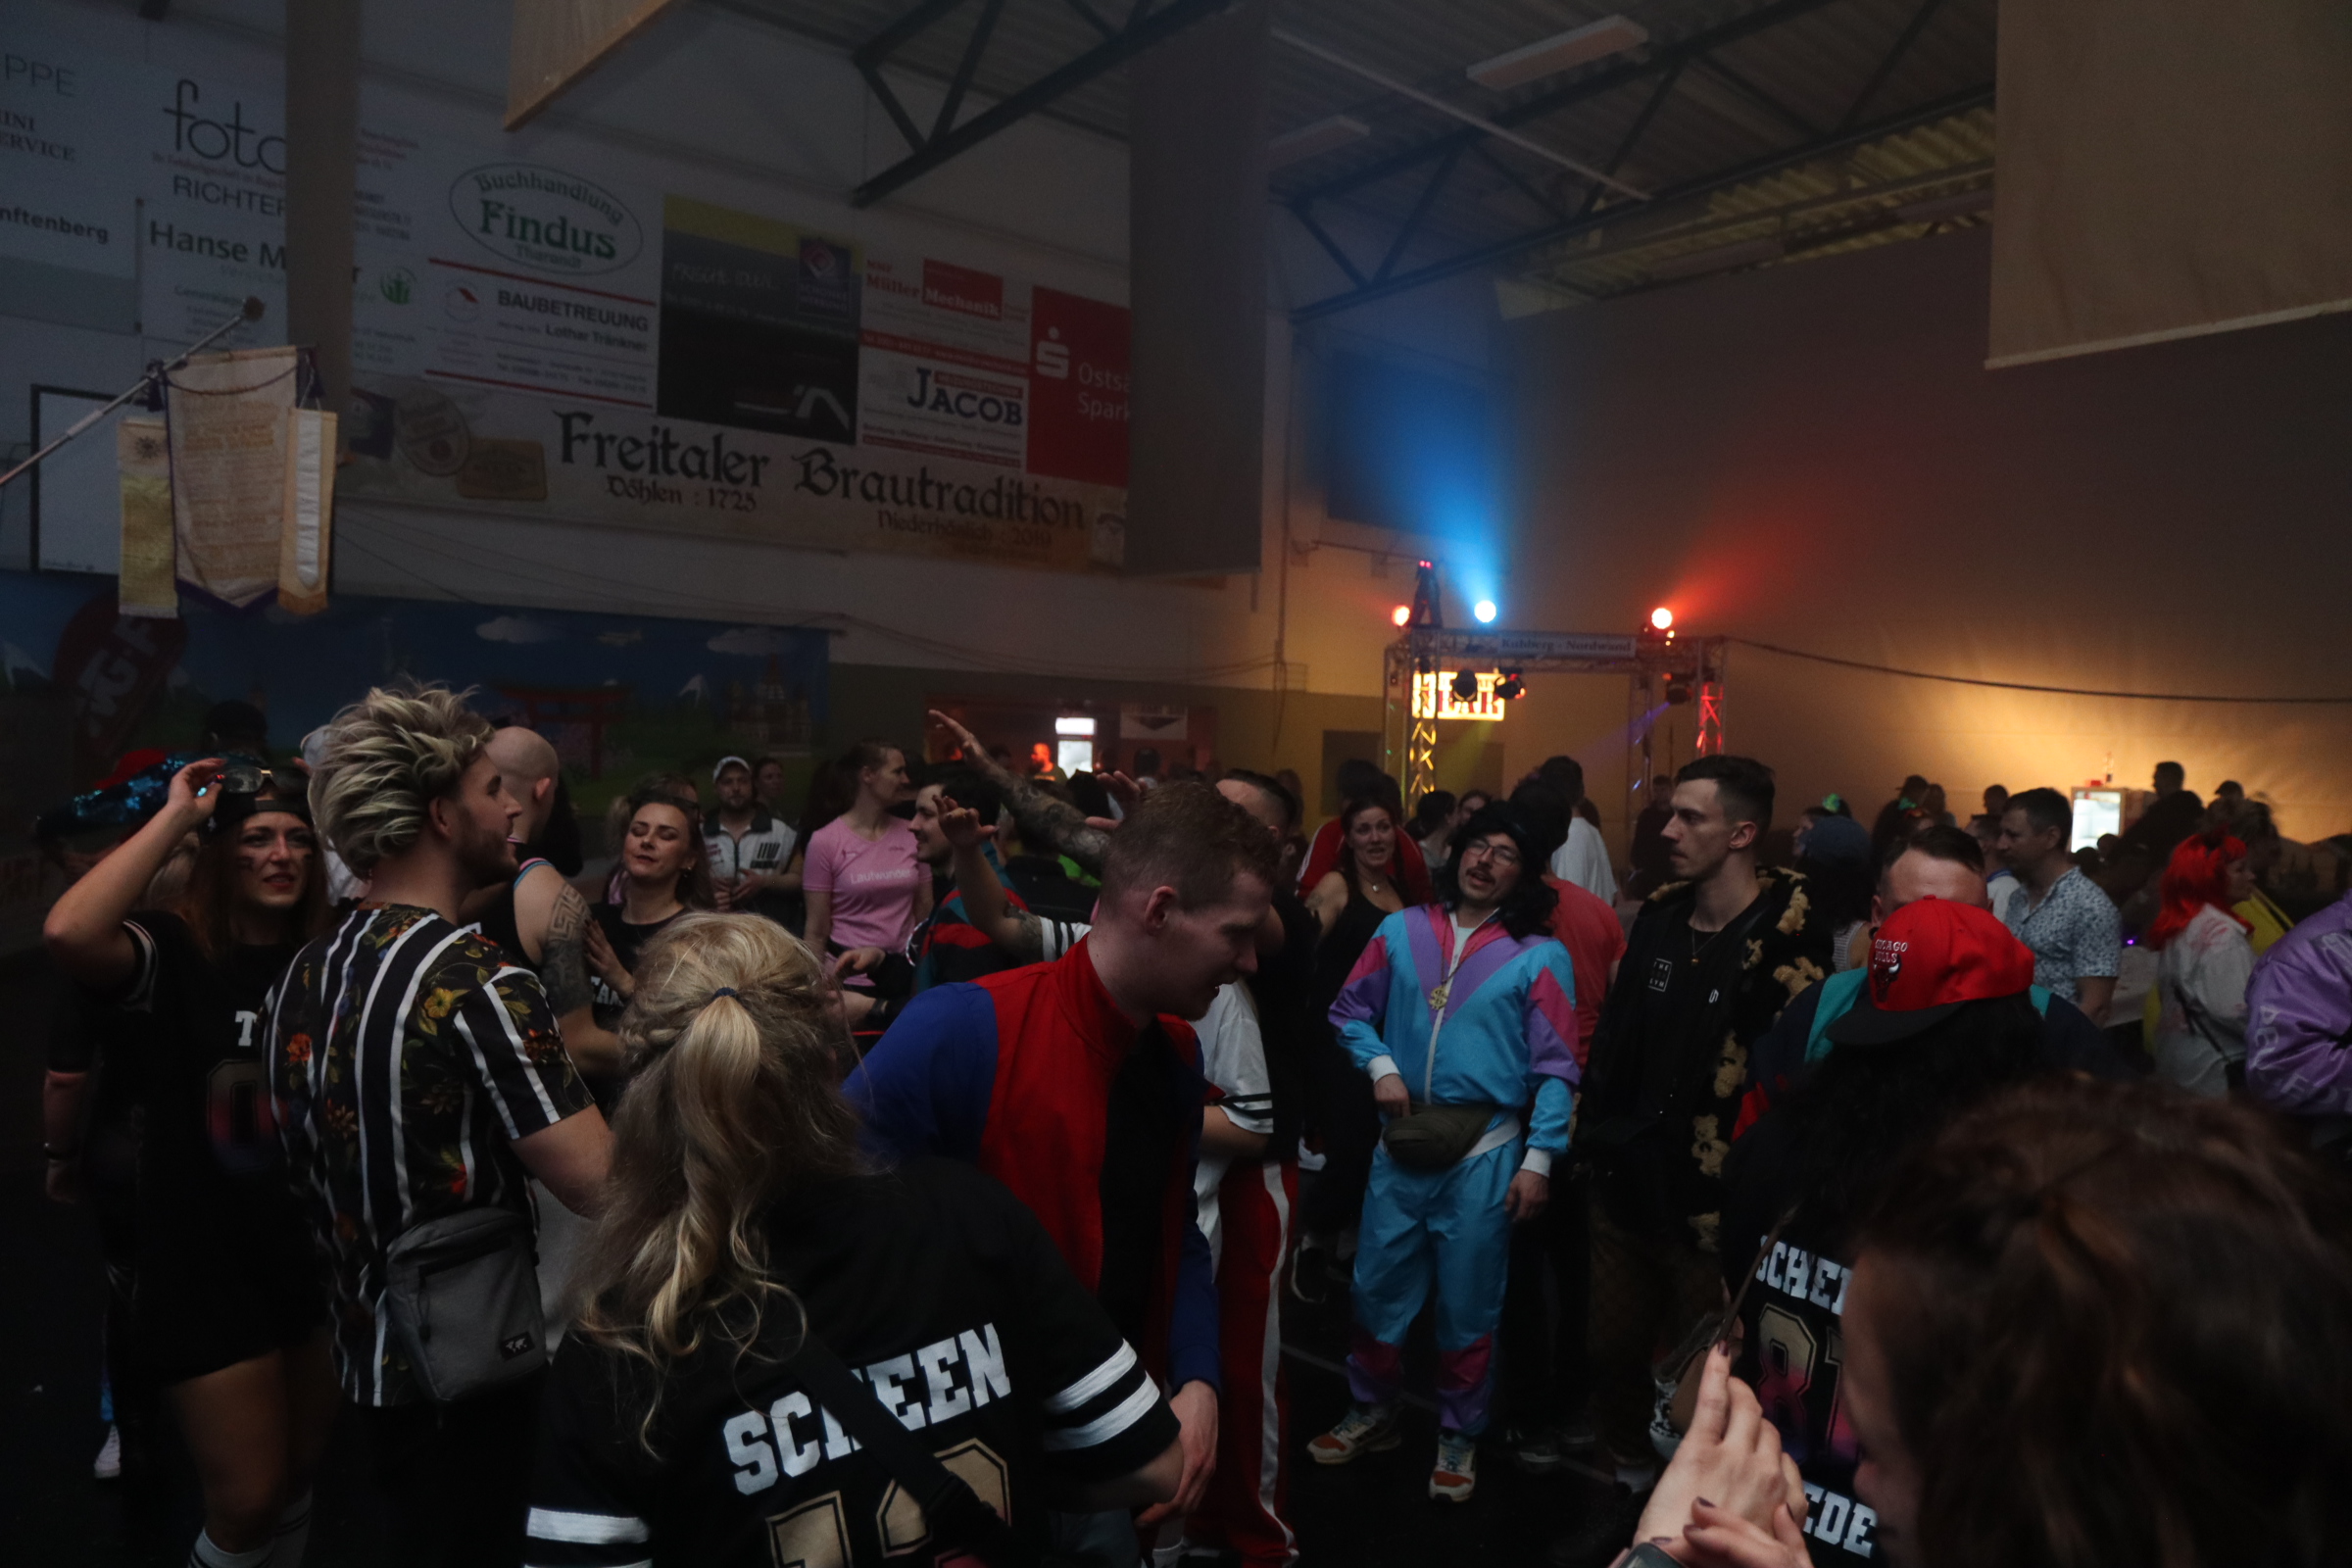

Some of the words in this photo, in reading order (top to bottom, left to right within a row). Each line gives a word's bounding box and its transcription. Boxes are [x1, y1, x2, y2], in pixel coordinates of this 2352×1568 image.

[474, 171, 625, 226] Buchhandlung
[150, 220, 249, 263] Hanse
[479, 198, 616, 260] Findus
[498, 290, 649, 331] BAUBETREUUNG
[925, 289, 1000, 317] Mechanik
[907, 367, 1023, 426] JACOB
[552, 410, 770, 488] Freitaler
[791, 447, 1085, 529] Brautradition
[607, 474, 683, 506] Döhlen
